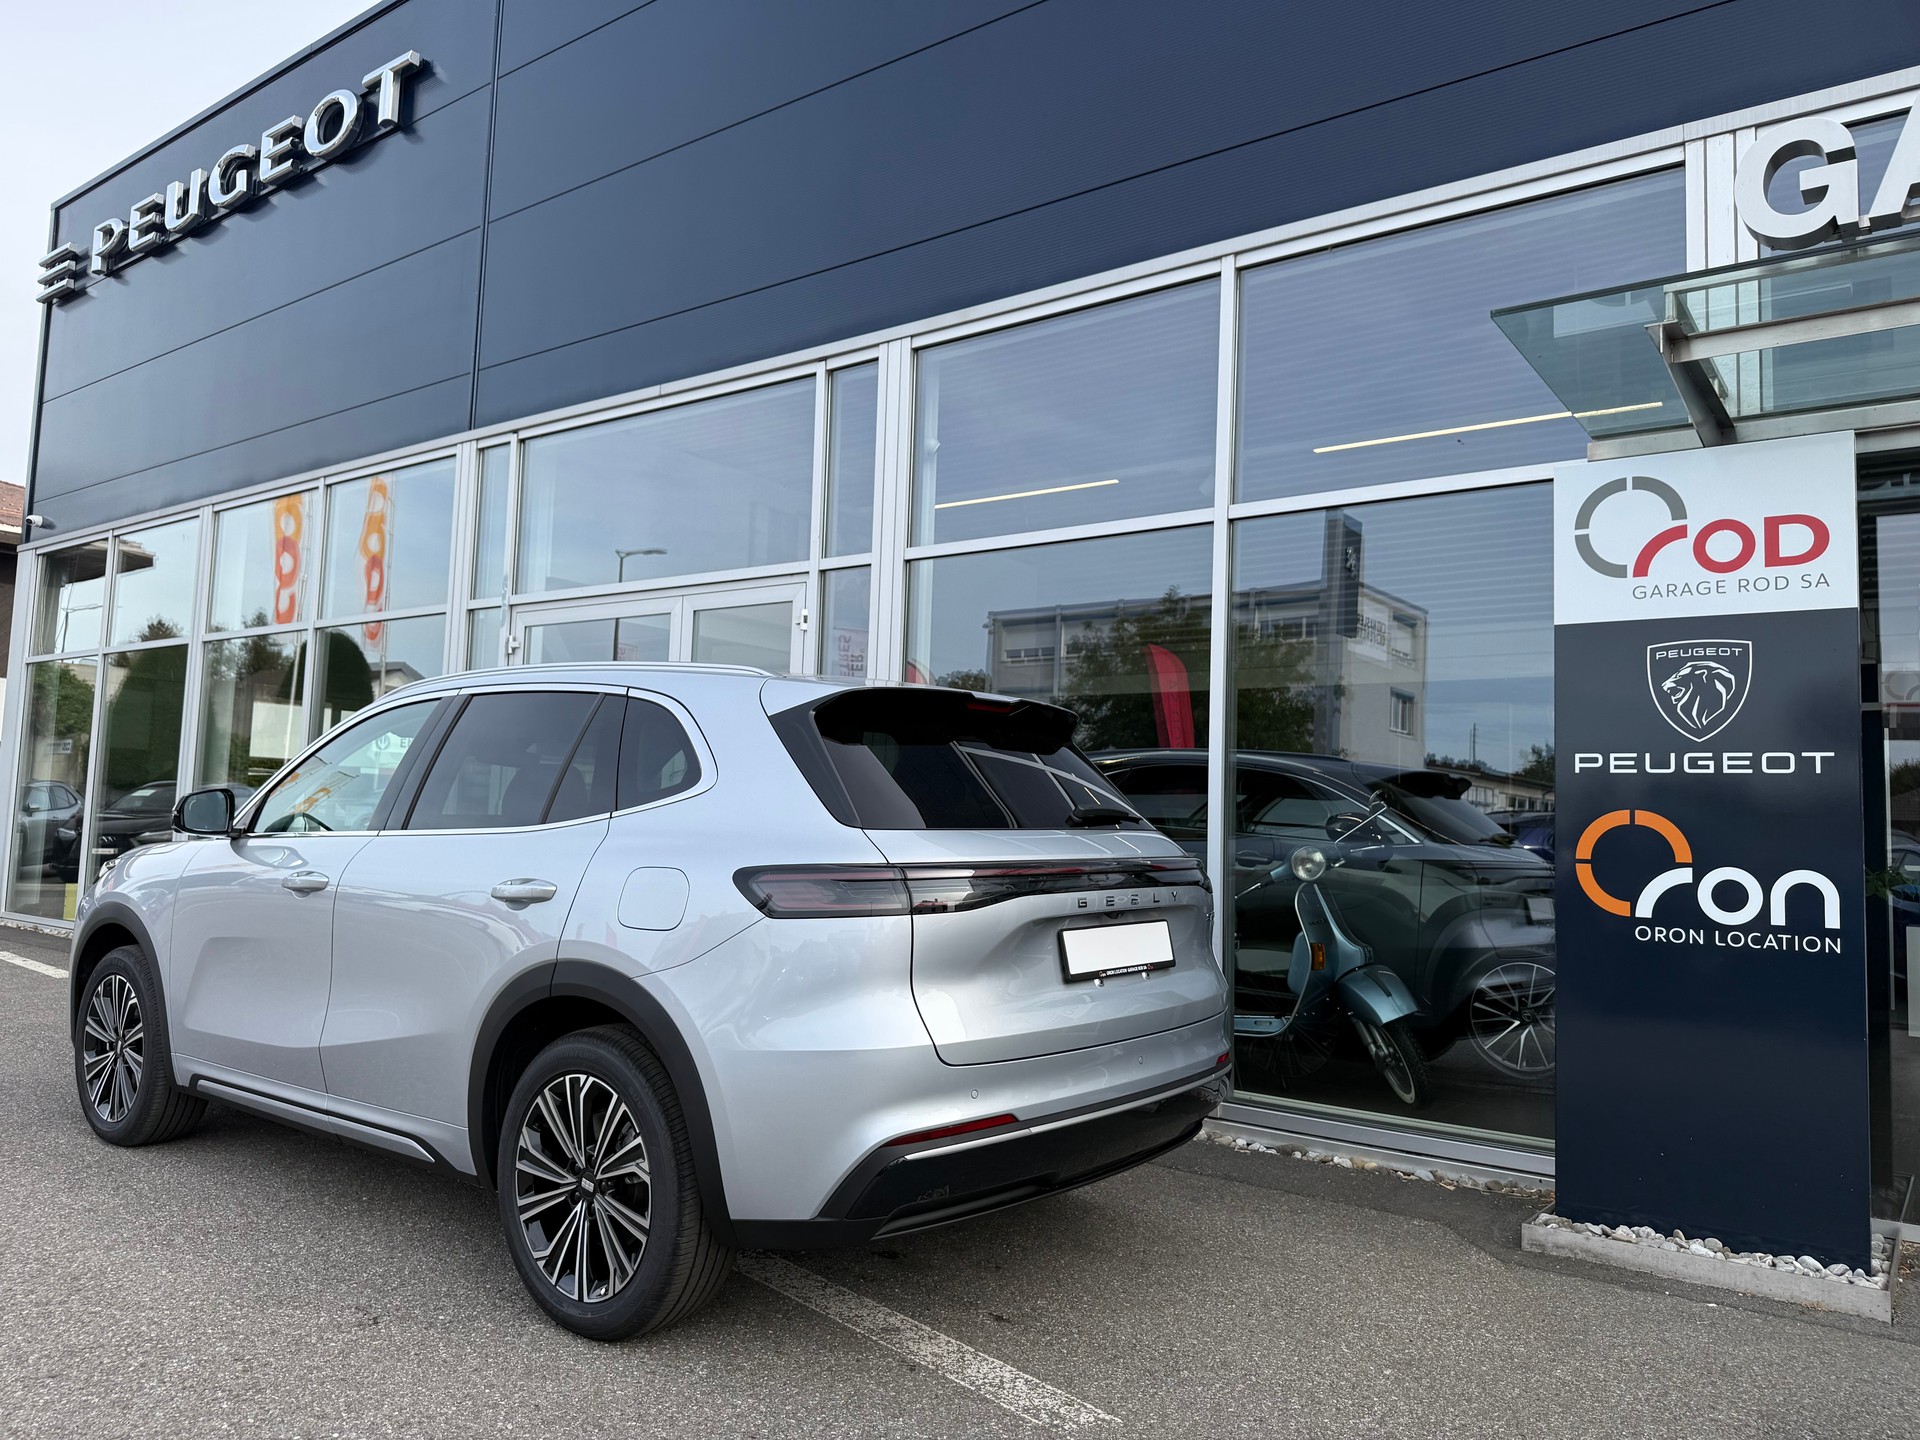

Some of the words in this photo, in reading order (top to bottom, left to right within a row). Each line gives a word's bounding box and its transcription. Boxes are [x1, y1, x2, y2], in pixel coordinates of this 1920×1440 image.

[91, 49, 423, 275] PEUGEOT
[1632, 579, 1727, 600] GARAGE
[1737, 575, 1790, 594] ROD
[1800, 572, 1831, 589] SA
[1655, 647, 1743, 660] PEUGEOT
[1574, 752, 1835, 774] PEUGEOT
[1077, 891, 1178, 908] GEELY
[1634, 925, 1704, 945] ORON
[1714, 930, 1842, 954] LOCATION
